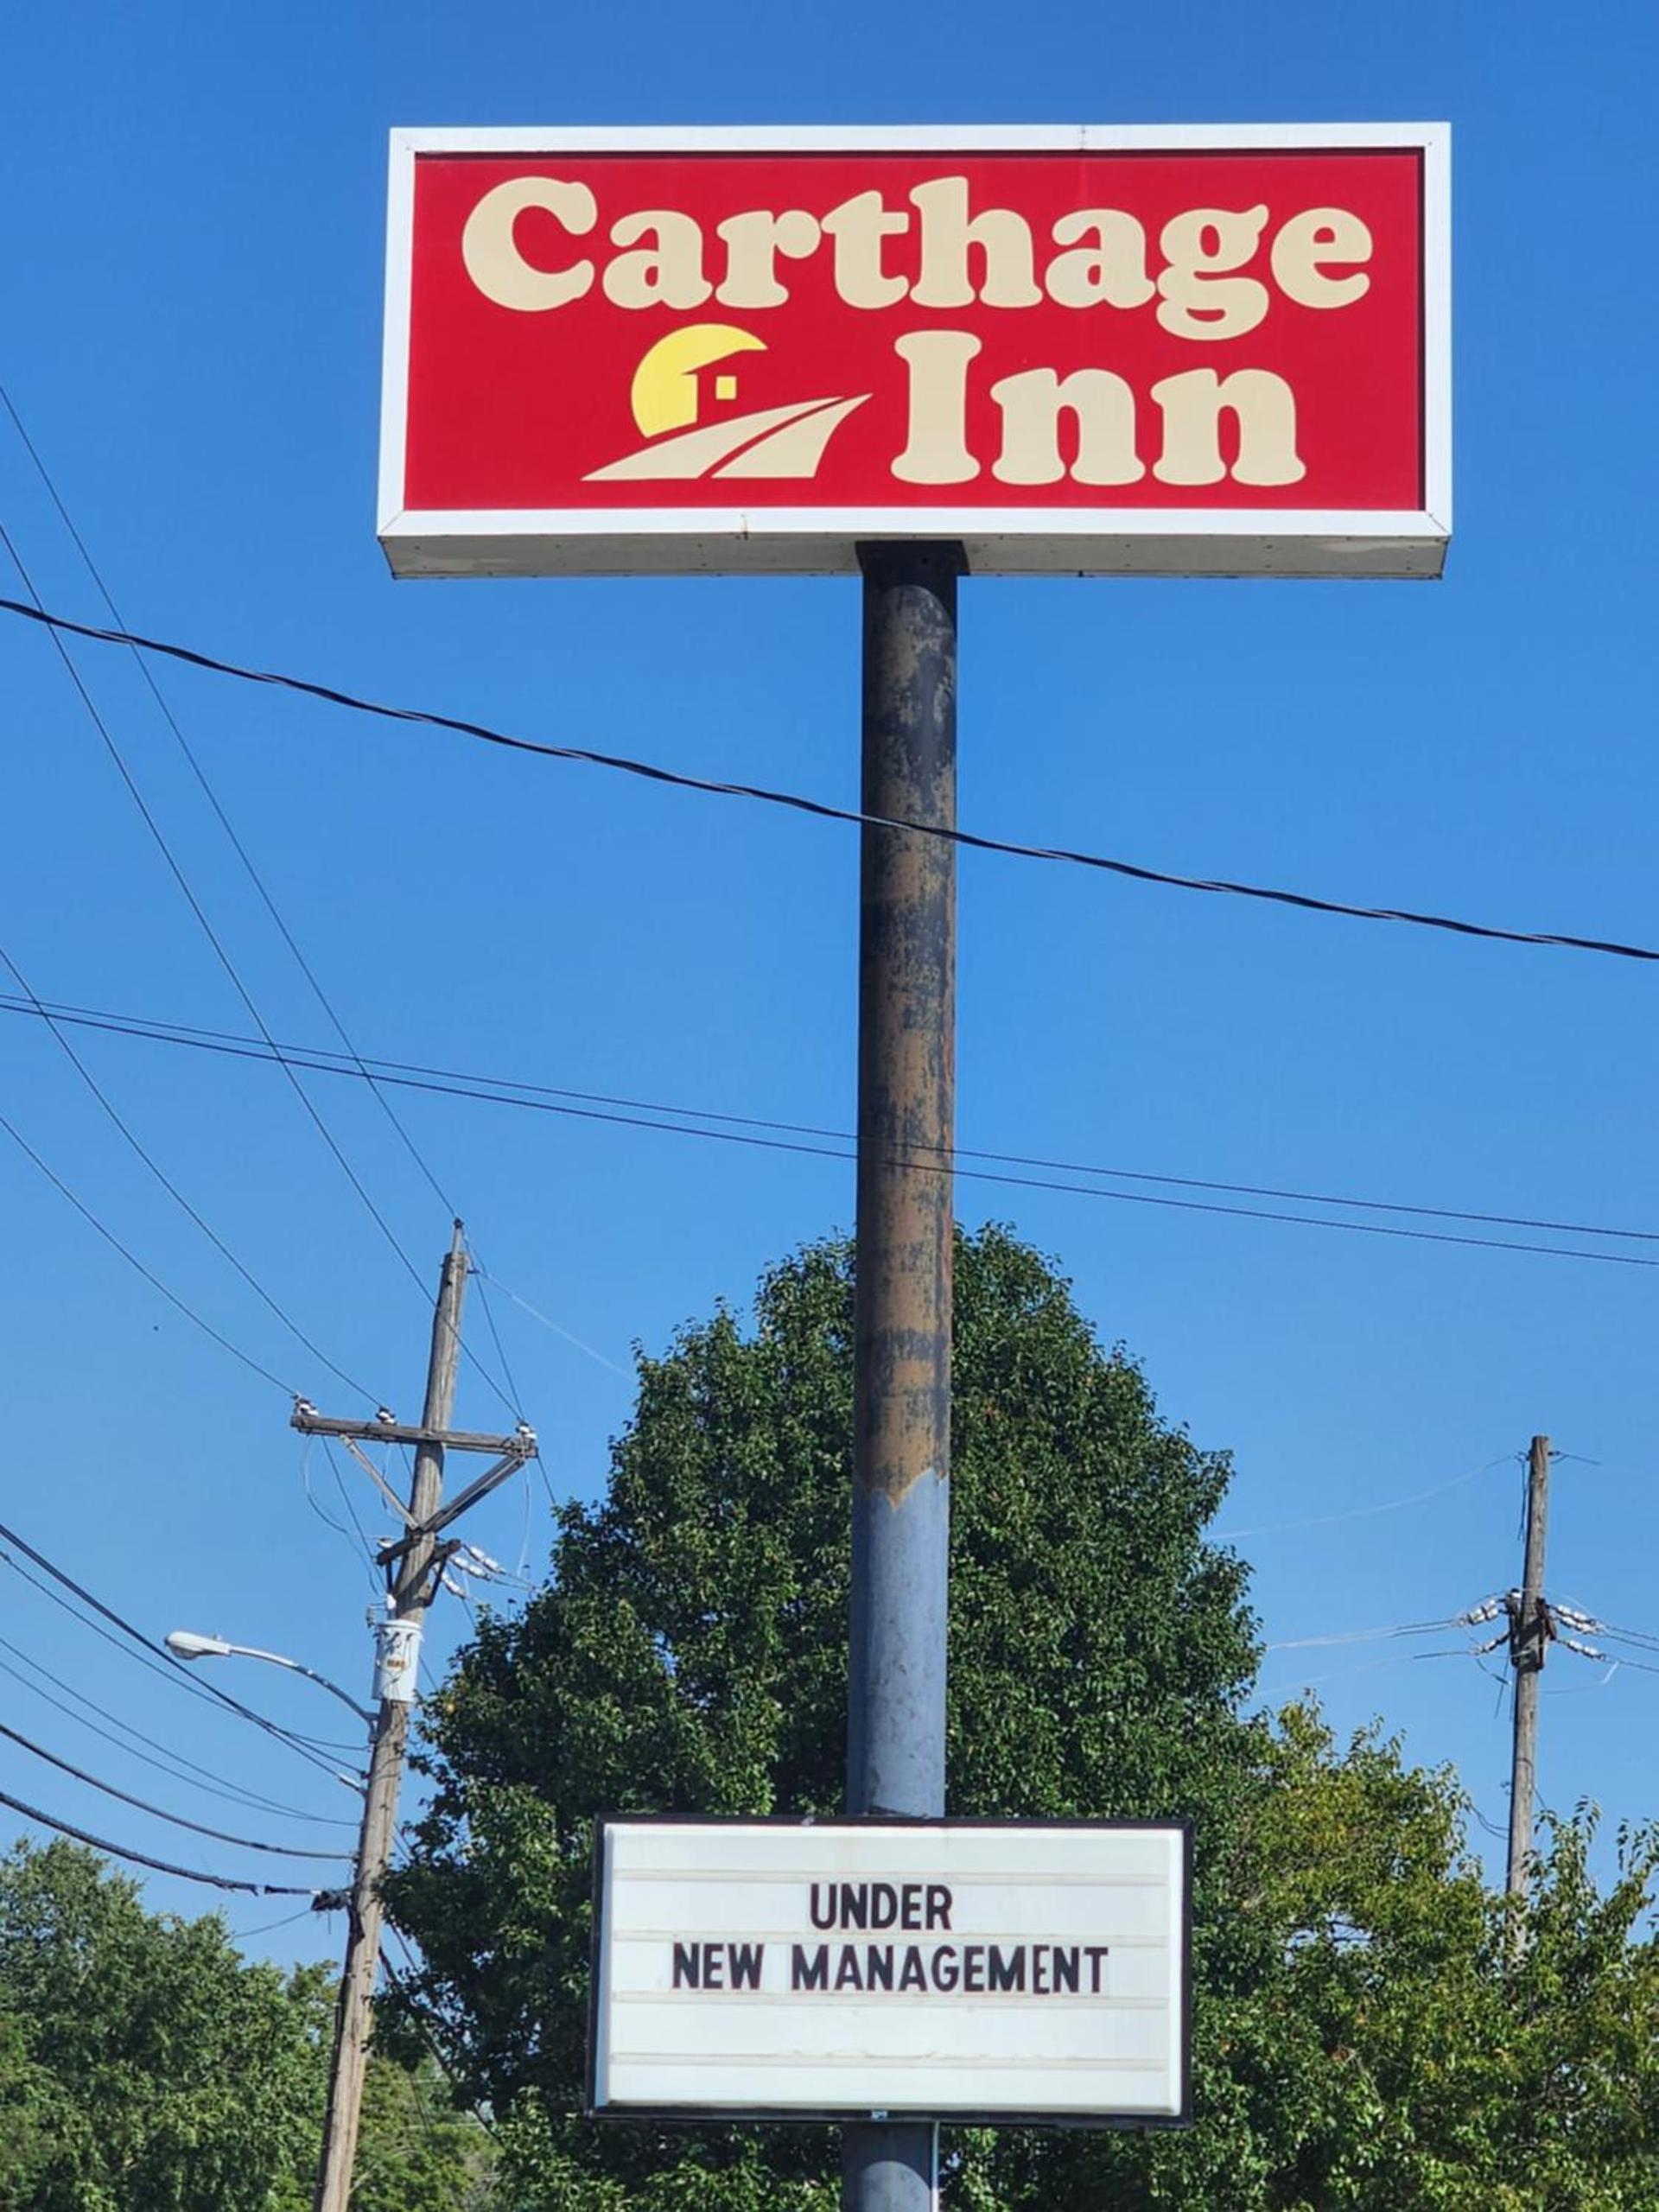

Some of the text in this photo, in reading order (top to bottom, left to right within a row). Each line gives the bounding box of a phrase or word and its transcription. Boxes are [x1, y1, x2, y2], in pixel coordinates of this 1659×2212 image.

[461, 175, 1374, 341] Carthage
[890, 330, 1306, 487] Inn
[810, 1883, 952, 1930] UNDER
[672, 1942, 1109, 1995] NEW MANAGEMENT
